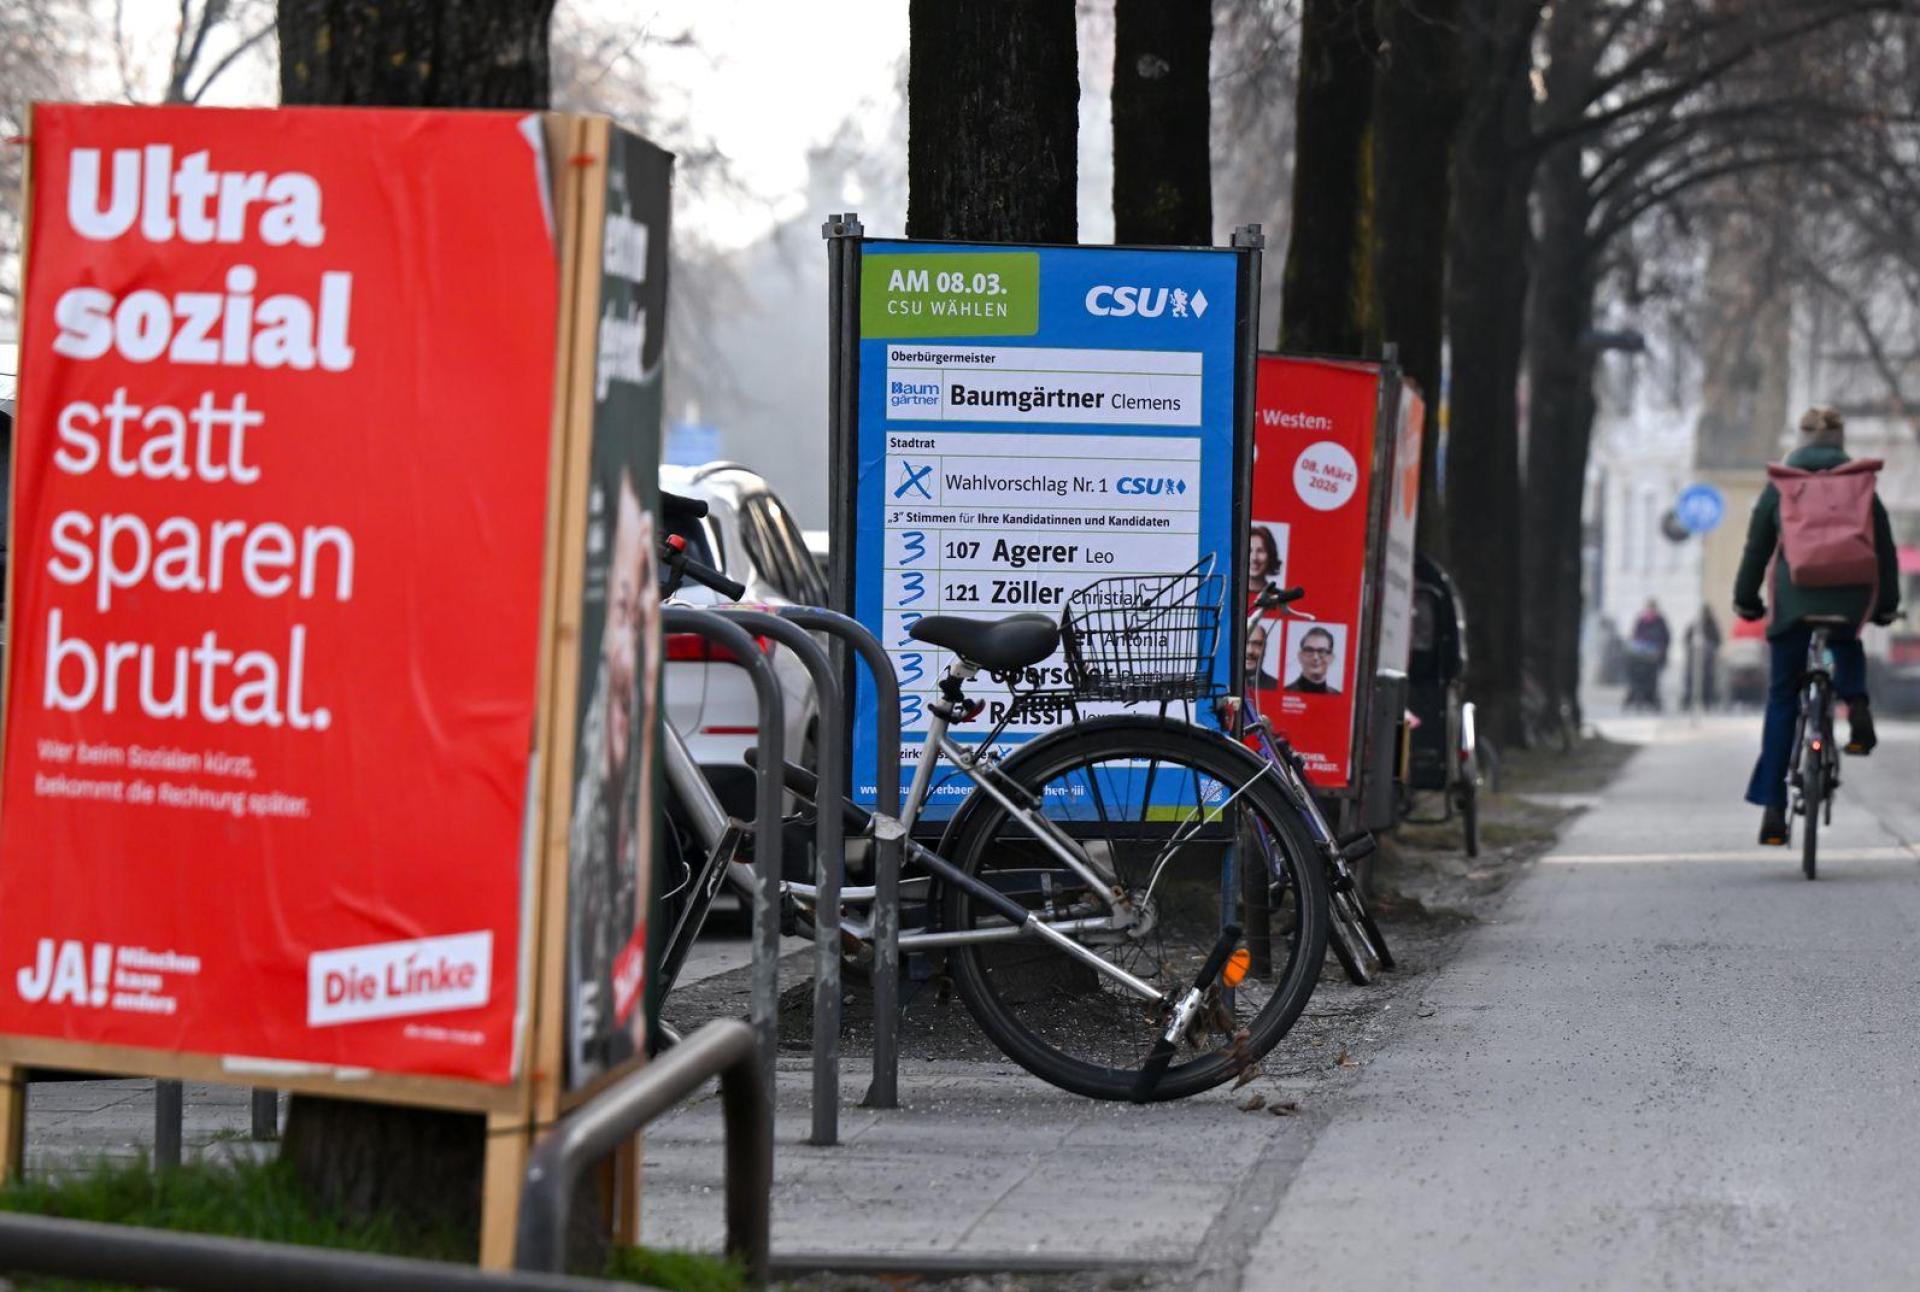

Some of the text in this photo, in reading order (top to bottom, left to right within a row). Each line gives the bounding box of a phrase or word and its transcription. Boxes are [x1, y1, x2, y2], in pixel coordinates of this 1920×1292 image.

[67, 144, 325, 248] Ultra
[888, 270, 1008, 295] AM 08.03.
[888, 298, 1008, 317] CSU WÄHLEN
[1085, 285, 1168, 318] CSU
[52, 264, 355, 372] sozial
[891, 350, 996, 365] Oberbürgermeister
[891, 381, 939, 395] Baum
[891, 393, 940, 407] gärtner
[951, 384, 1181, 412] Baumgärtner Clemens
[53, 387, 264, 484] statt
[1263, 409, 1333, 430] Westen:
[890, 437, 935, 449] Stadtrat
[946, 474, 1108, 496] Wahlvorschlag Nr. 1
[1116, 477, 1163, 494] CSU
[1301, 459, 1353, 482] 08. März
[1309, 476, 1339, 493] 2026
[906, 511, 956, 524] Stimmen
[959, 512, 976, 524] für
[978, 513, 1000, 525] Ihre
[1002, 514, 1081, 527] Kandidatinnen
[1085, 515, 1105, 527] und
[1109, 516, 1170, 528] Kandidaten
[46, 510, 355, 612] sparen
[899, 531, 1114, 567] 3 107 Agerer Leo
[899, 571, 1143, 606] 3 121 Zöller Christian
[43, 608, 331, 731] brutal.
[899, 653, 923, 687] 3
[899, 695, 923, 727] 3
[37, 739, 73, 762] Wer
[76, 740, 124, 767] beim
[127, 745, 201, 772] Sozialen
[34, 773, 123, 802] bekommt
[126, 780, 155, 805] die
[157, 781, 246, 816] Rechnung
[16, 937, 113, 1008] JA!
[325, 953, 475, 1006] Die Linke
